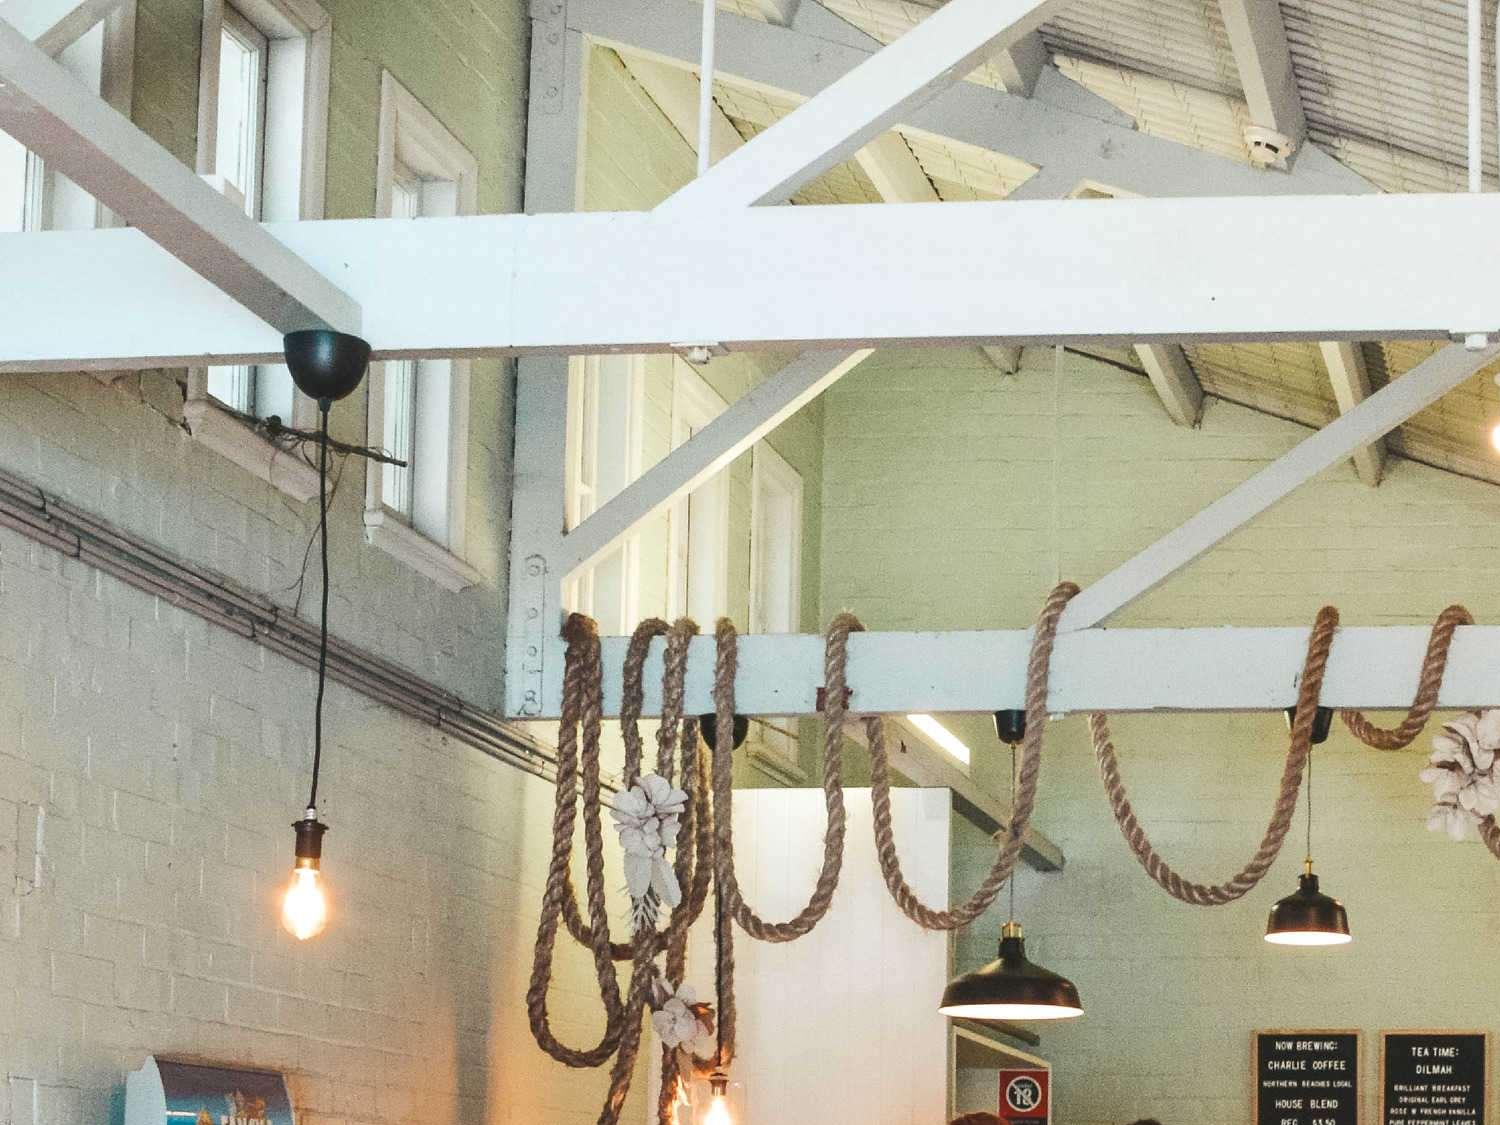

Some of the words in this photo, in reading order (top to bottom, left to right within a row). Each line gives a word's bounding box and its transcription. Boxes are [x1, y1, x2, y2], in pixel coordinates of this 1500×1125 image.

[1275, 1041, 1293, 1051] NOW
[1296, 1041, 1338, 1051] BREWING:
[1412, 1047, 1429, 1057] TEA
[1433, 1047, 1459, 1057] TIME:
[1268, 1061, 1306, 1071] CHARLIE
[1312, 1061, 1346, 1070] COFFEE
[1416, 1064, 1452, 1074] DILMAH
[1275, 1099, 1303, 1109] HOUSE
[1310, 1099, 1338, 1109] BLEND
